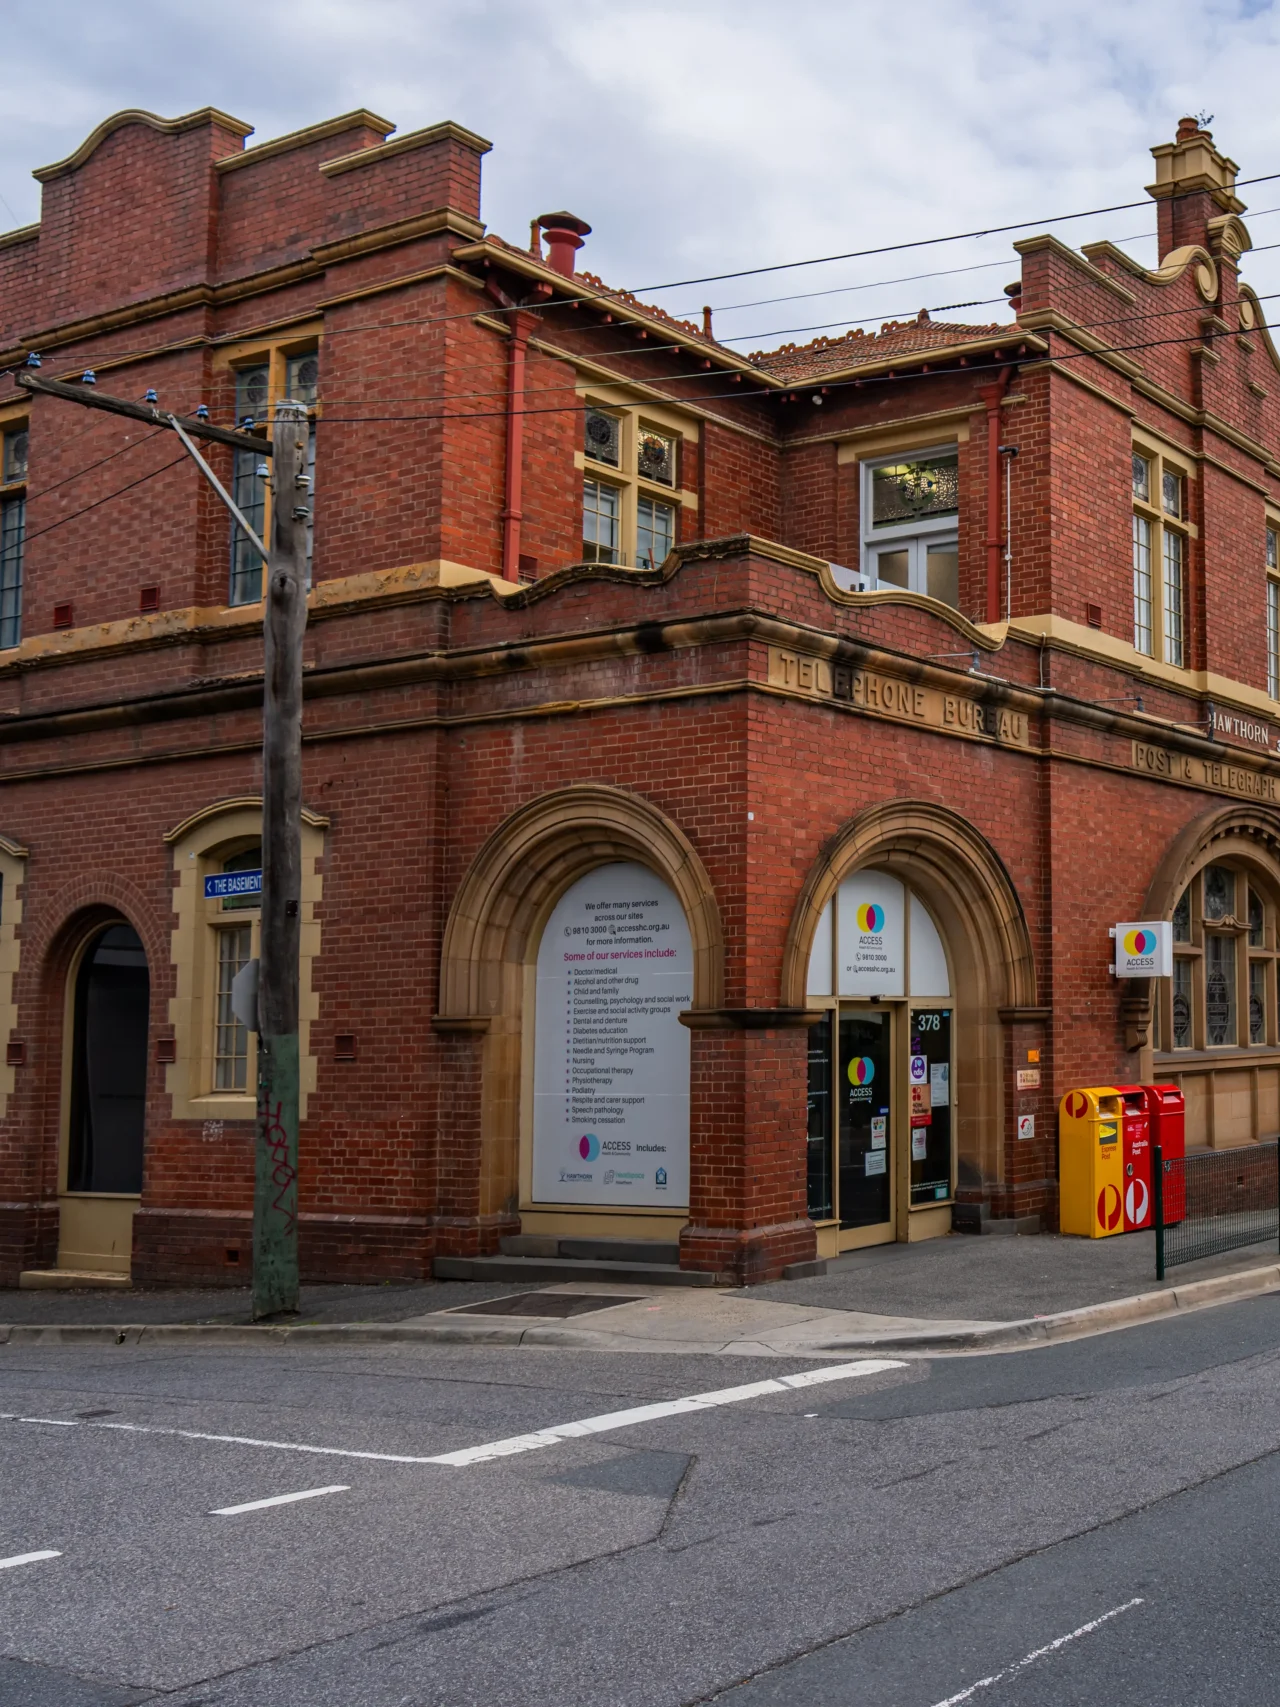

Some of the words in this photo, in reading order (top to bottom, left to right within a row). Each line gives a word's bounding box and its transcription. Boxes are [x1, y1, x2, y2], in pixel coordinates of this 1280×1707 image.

[780, 652, 925, 718] TELEPHONE
[943, 696, 1022, 741] BUREAU
[1208, 711, 1269, 745] HAWTHORN
[1135, 743, 1176, 774] POST
[1184, 759, 1192, 778] &
[1202, 761, 1276, 801] TELEGRAPH
[214, 878, 227, 893] THE
[227, 875, 262, 891] BASEMENT
[597, 902, 611, 910] offer
[613, 901, 630, 909] many
[628, 912, 643, 920] sites
[616, 923, 670, 932] accesshc.org.au
[859, 936, 882, 945] ACCESS
[564, 953, 585, 961] Some
[587, 951, 595, 960] of
[597, 952, 608, 960] our
[610, 950, 643, 959] services
[644, 948, 677, 958] include:
[1126, 958, 1154, 966] ACCESS
[625, 977, 639, 985] drug
[602, 987, 619, 995] family
[610, 997, 643, 1005] psychology
[628, 1006, 648, 1014] activity
[650, 1006, 670, 1014] groups
[918, 1014, 940, 1031] 378
[623, 1037, 646, 1045] support
[606, 1047, 628, 1055] Syringe
[629, 1047, 654, 1055] Program
[573, 1057, 595, 1065] Nursing
[611, 1067, 633, 1075] therapy
[572, 1077, 612, 1085] Physiotherapy
[572, 1087, 595, 1095] Podiatry
[850, 1088, 872, 1097] ACCESS
[572, 1106, 593, 1114] Speech
[594, 1107, 624, 1115] pathology
[572, 1117, 596, 1125] Smoking
[602, 1141, 631, 1150] ACCESS
[636, 1144, 666, 1152] Includes:
